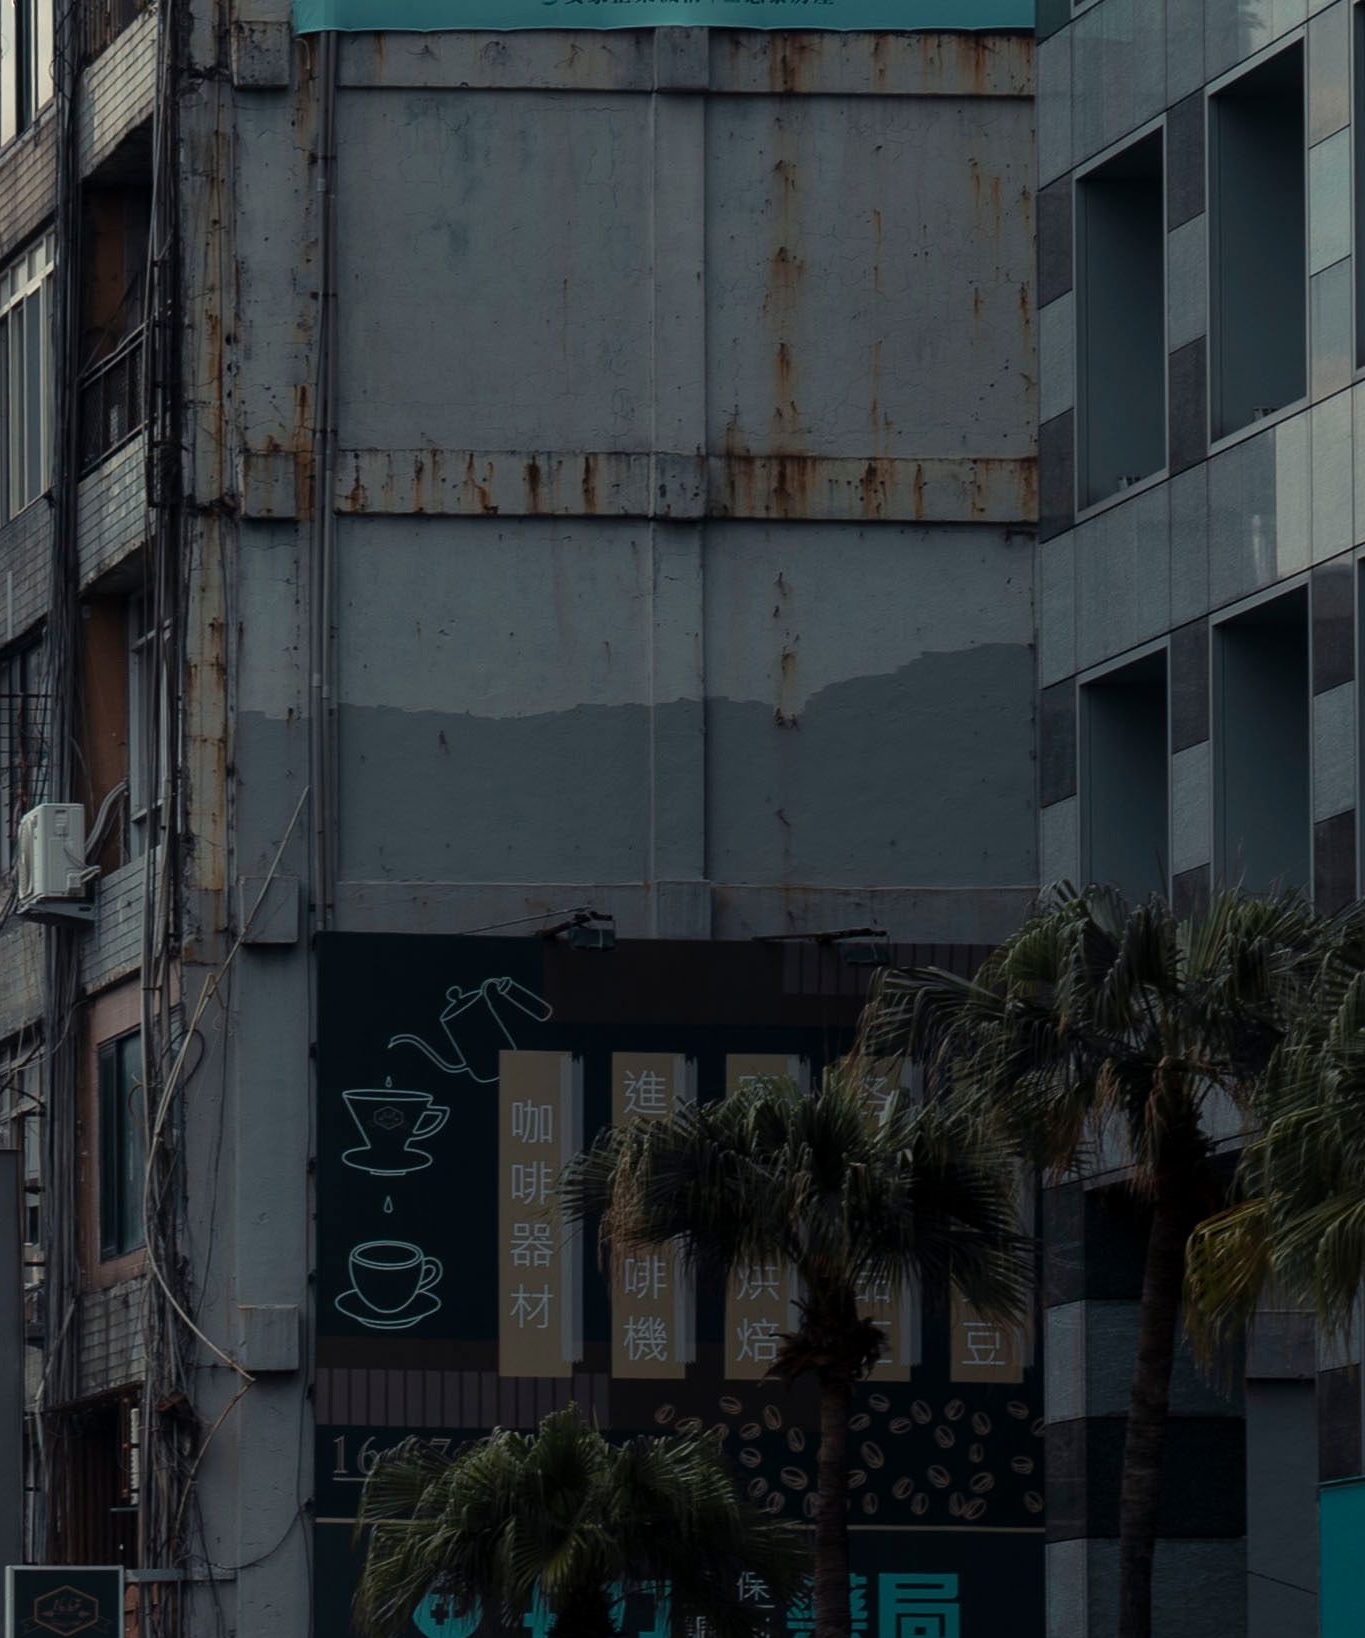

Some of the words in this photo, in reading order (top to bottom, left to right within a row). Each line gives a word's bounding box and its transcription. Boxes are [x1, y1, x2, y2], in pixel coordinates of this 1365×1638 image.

[509, 1099, 555, 1329] 咖啡器材
[622, 1070, 668, 1362] 進啡機
